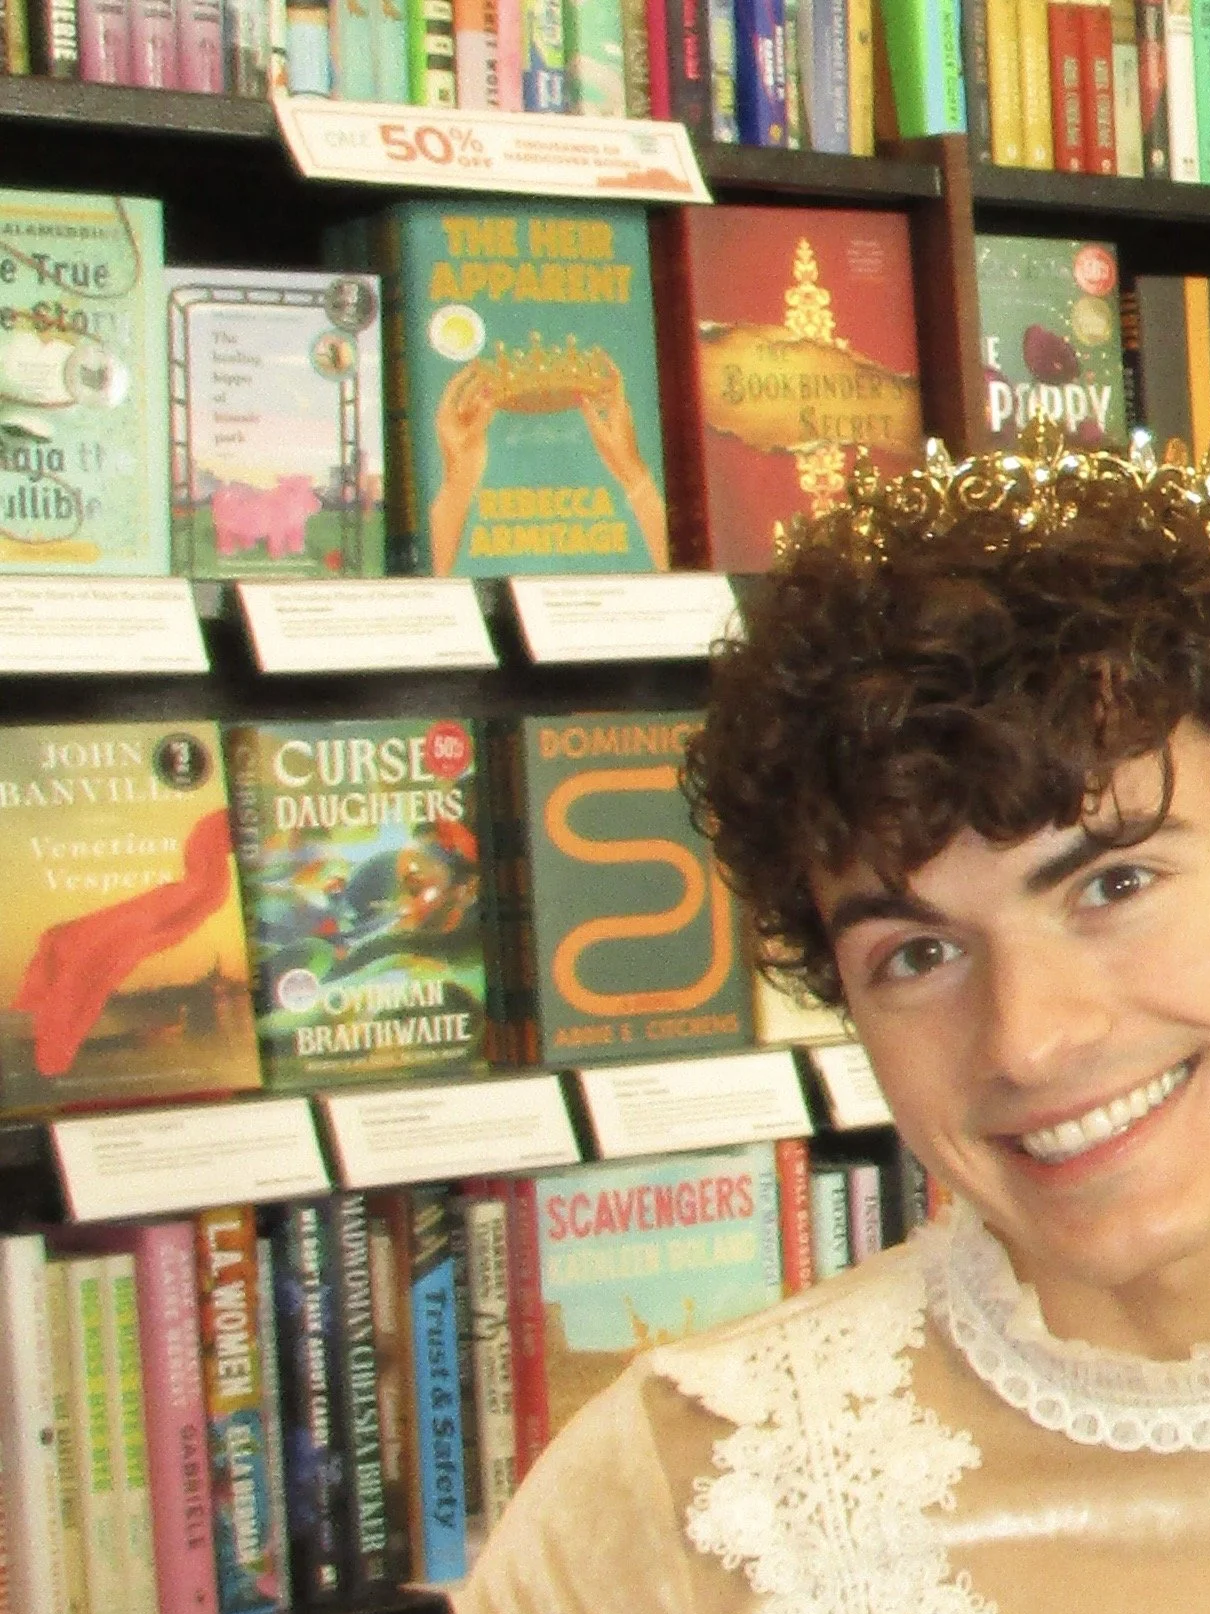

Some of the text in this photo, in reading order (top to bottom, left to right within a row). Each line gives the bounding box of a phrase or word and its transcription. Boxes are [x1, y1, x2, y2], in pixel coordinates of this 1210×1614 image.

[378, 124, 484, 165] 50%
[457, 156, 494, 169] OFF
[442, 215, 614, 260] THE HEIR
[32, 253, 109, 287] True
[430, 261, 632, 303] APPARENT
[800, 406, 892, 441] SECRET
[988, 380, 1112, 433] POPPY
[0, 445, 64, 482] aja
[4, 487, 100, 520] ullible
[479, 487, 613, 518] REBECCA
[469, 522, 628, 557] ARMITAGE
[41, 741, 143, 773] JOHN
[273, 736, 474, 787] CURSE
[0, 776, 192, 807] BANVILL
[274, 789, 464, 831] DAUGHTERS
[30, 834, 179, 862] Venetian
[45, 867, 174, 893] Vespers
[297, 1013, 473, 1056] BRAITHWAITE
[545, 1173, 755, 1242] SCAVENGERS
[341, 1195, 373, 1343] MADWOMAN
[213, 1280, 253, 1397] WOMEN
[350, 1345, 379, 1458] CHELSEA
[425, 1288, 458, 1530] Trust & Safety
